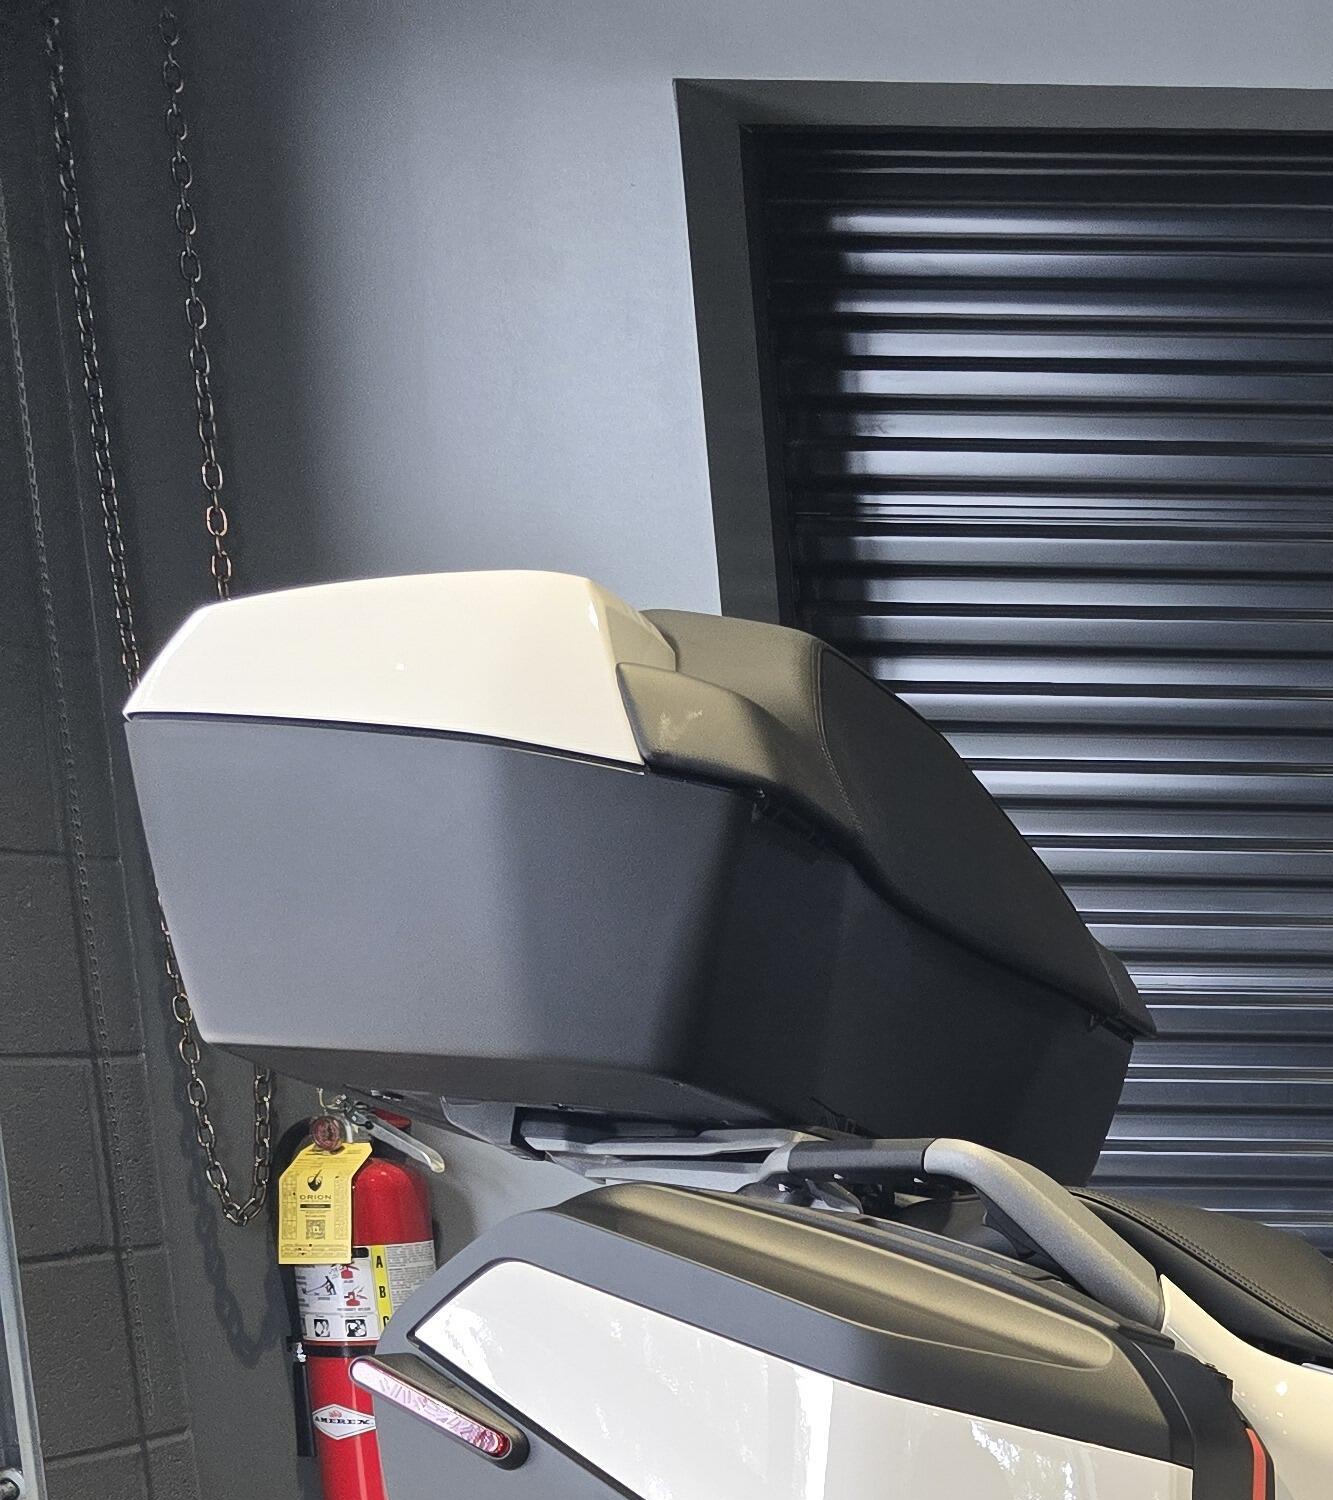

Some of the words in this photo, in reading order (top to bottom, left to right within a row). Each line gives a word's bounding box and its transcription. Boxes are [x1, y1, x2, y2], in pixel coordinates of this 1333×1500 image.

[375, 1255, 384, 1269] A
[378, 1285, 387, 1299] B
[314, 1415, 371, 1426] AMEREX
